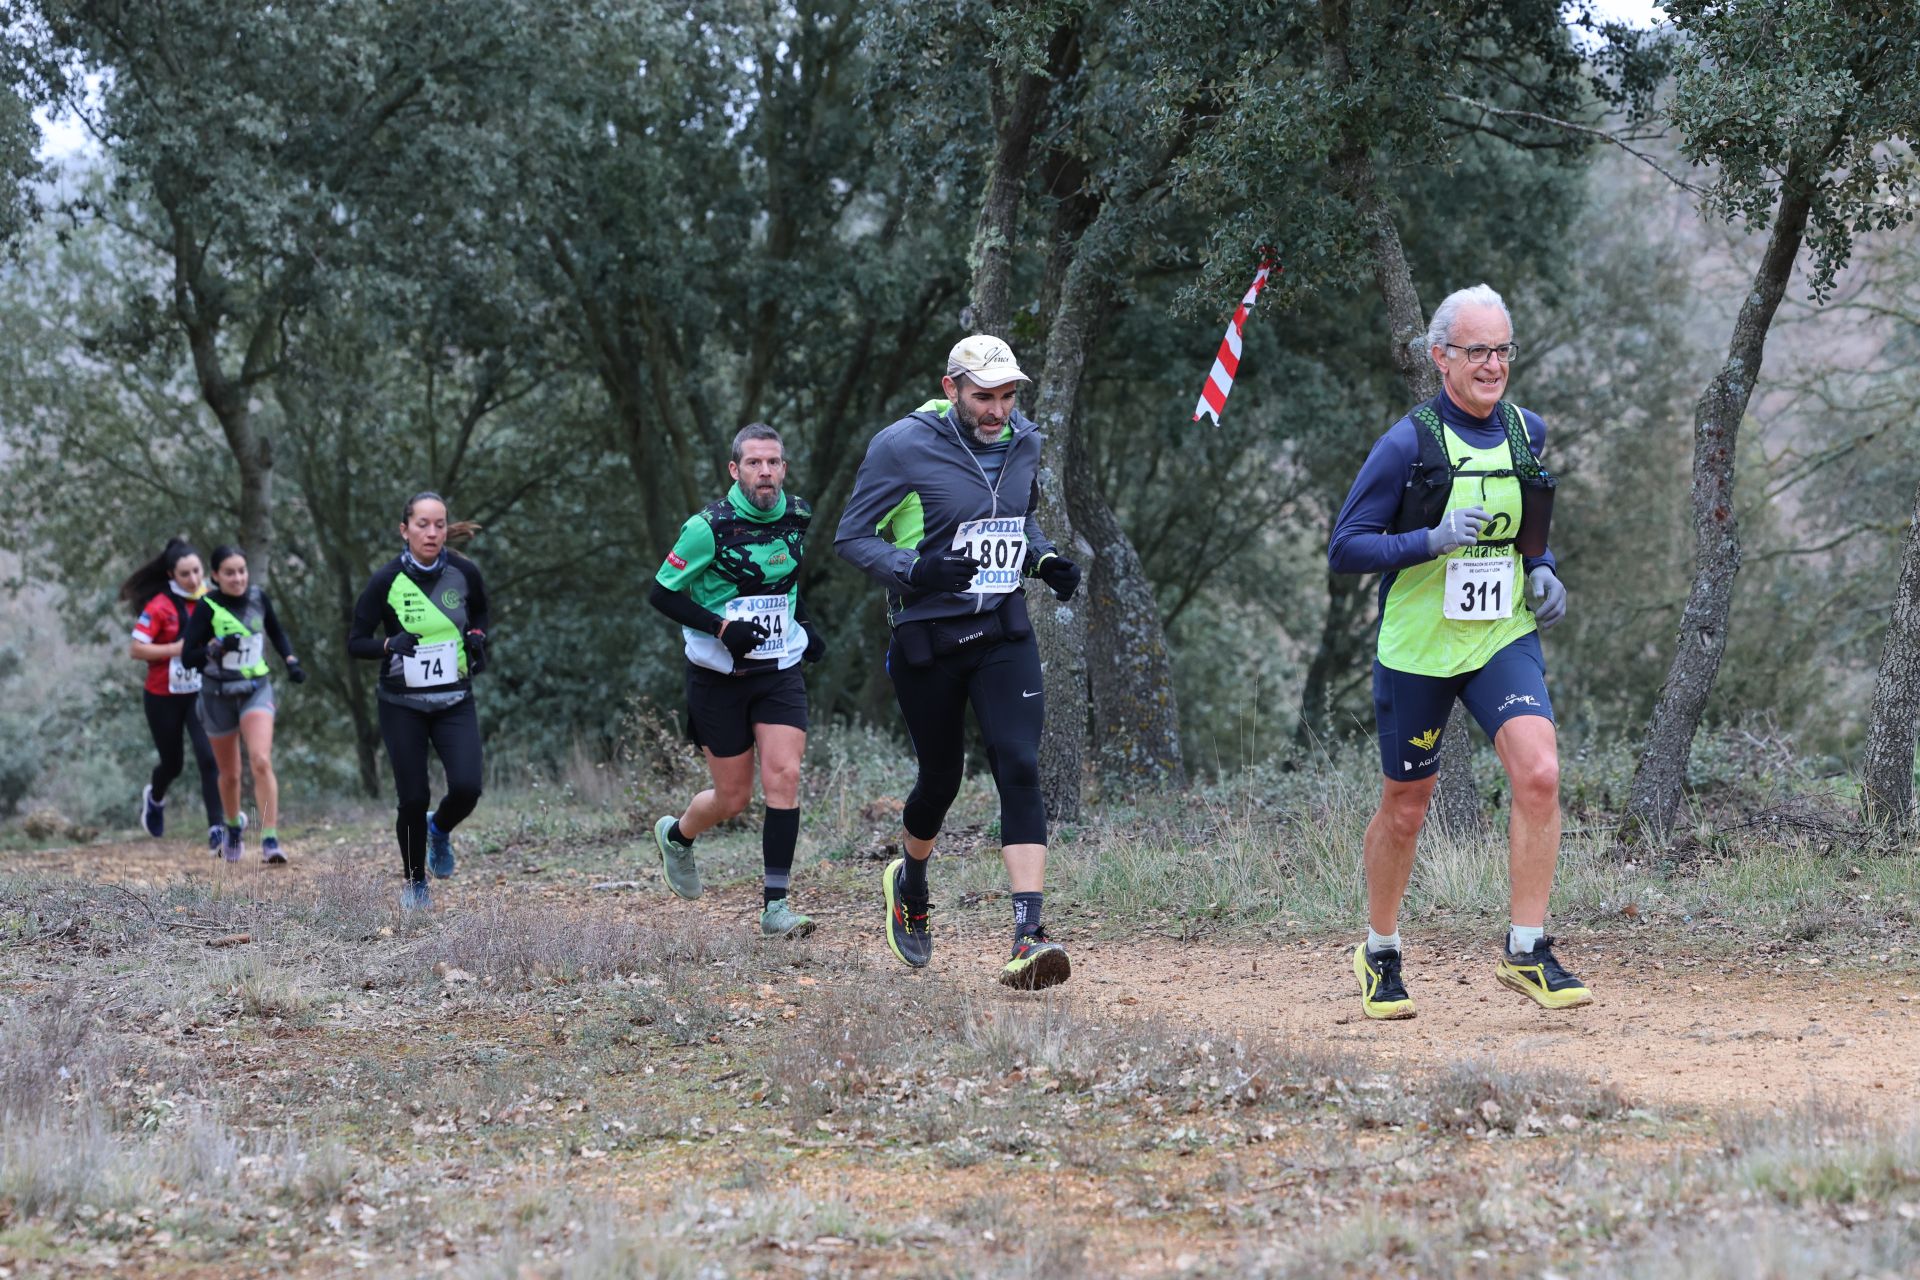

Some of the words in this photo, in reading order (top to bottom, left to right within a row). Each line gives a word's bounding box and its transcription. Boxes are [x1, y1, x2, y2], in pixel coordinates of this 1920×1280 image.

[965, 539, 1023, 569] 1807
[1460, 581, 1501, 612] 311
[959, 631, 983, 644] KIPRUN
[420, 657, 444, 680] 74
